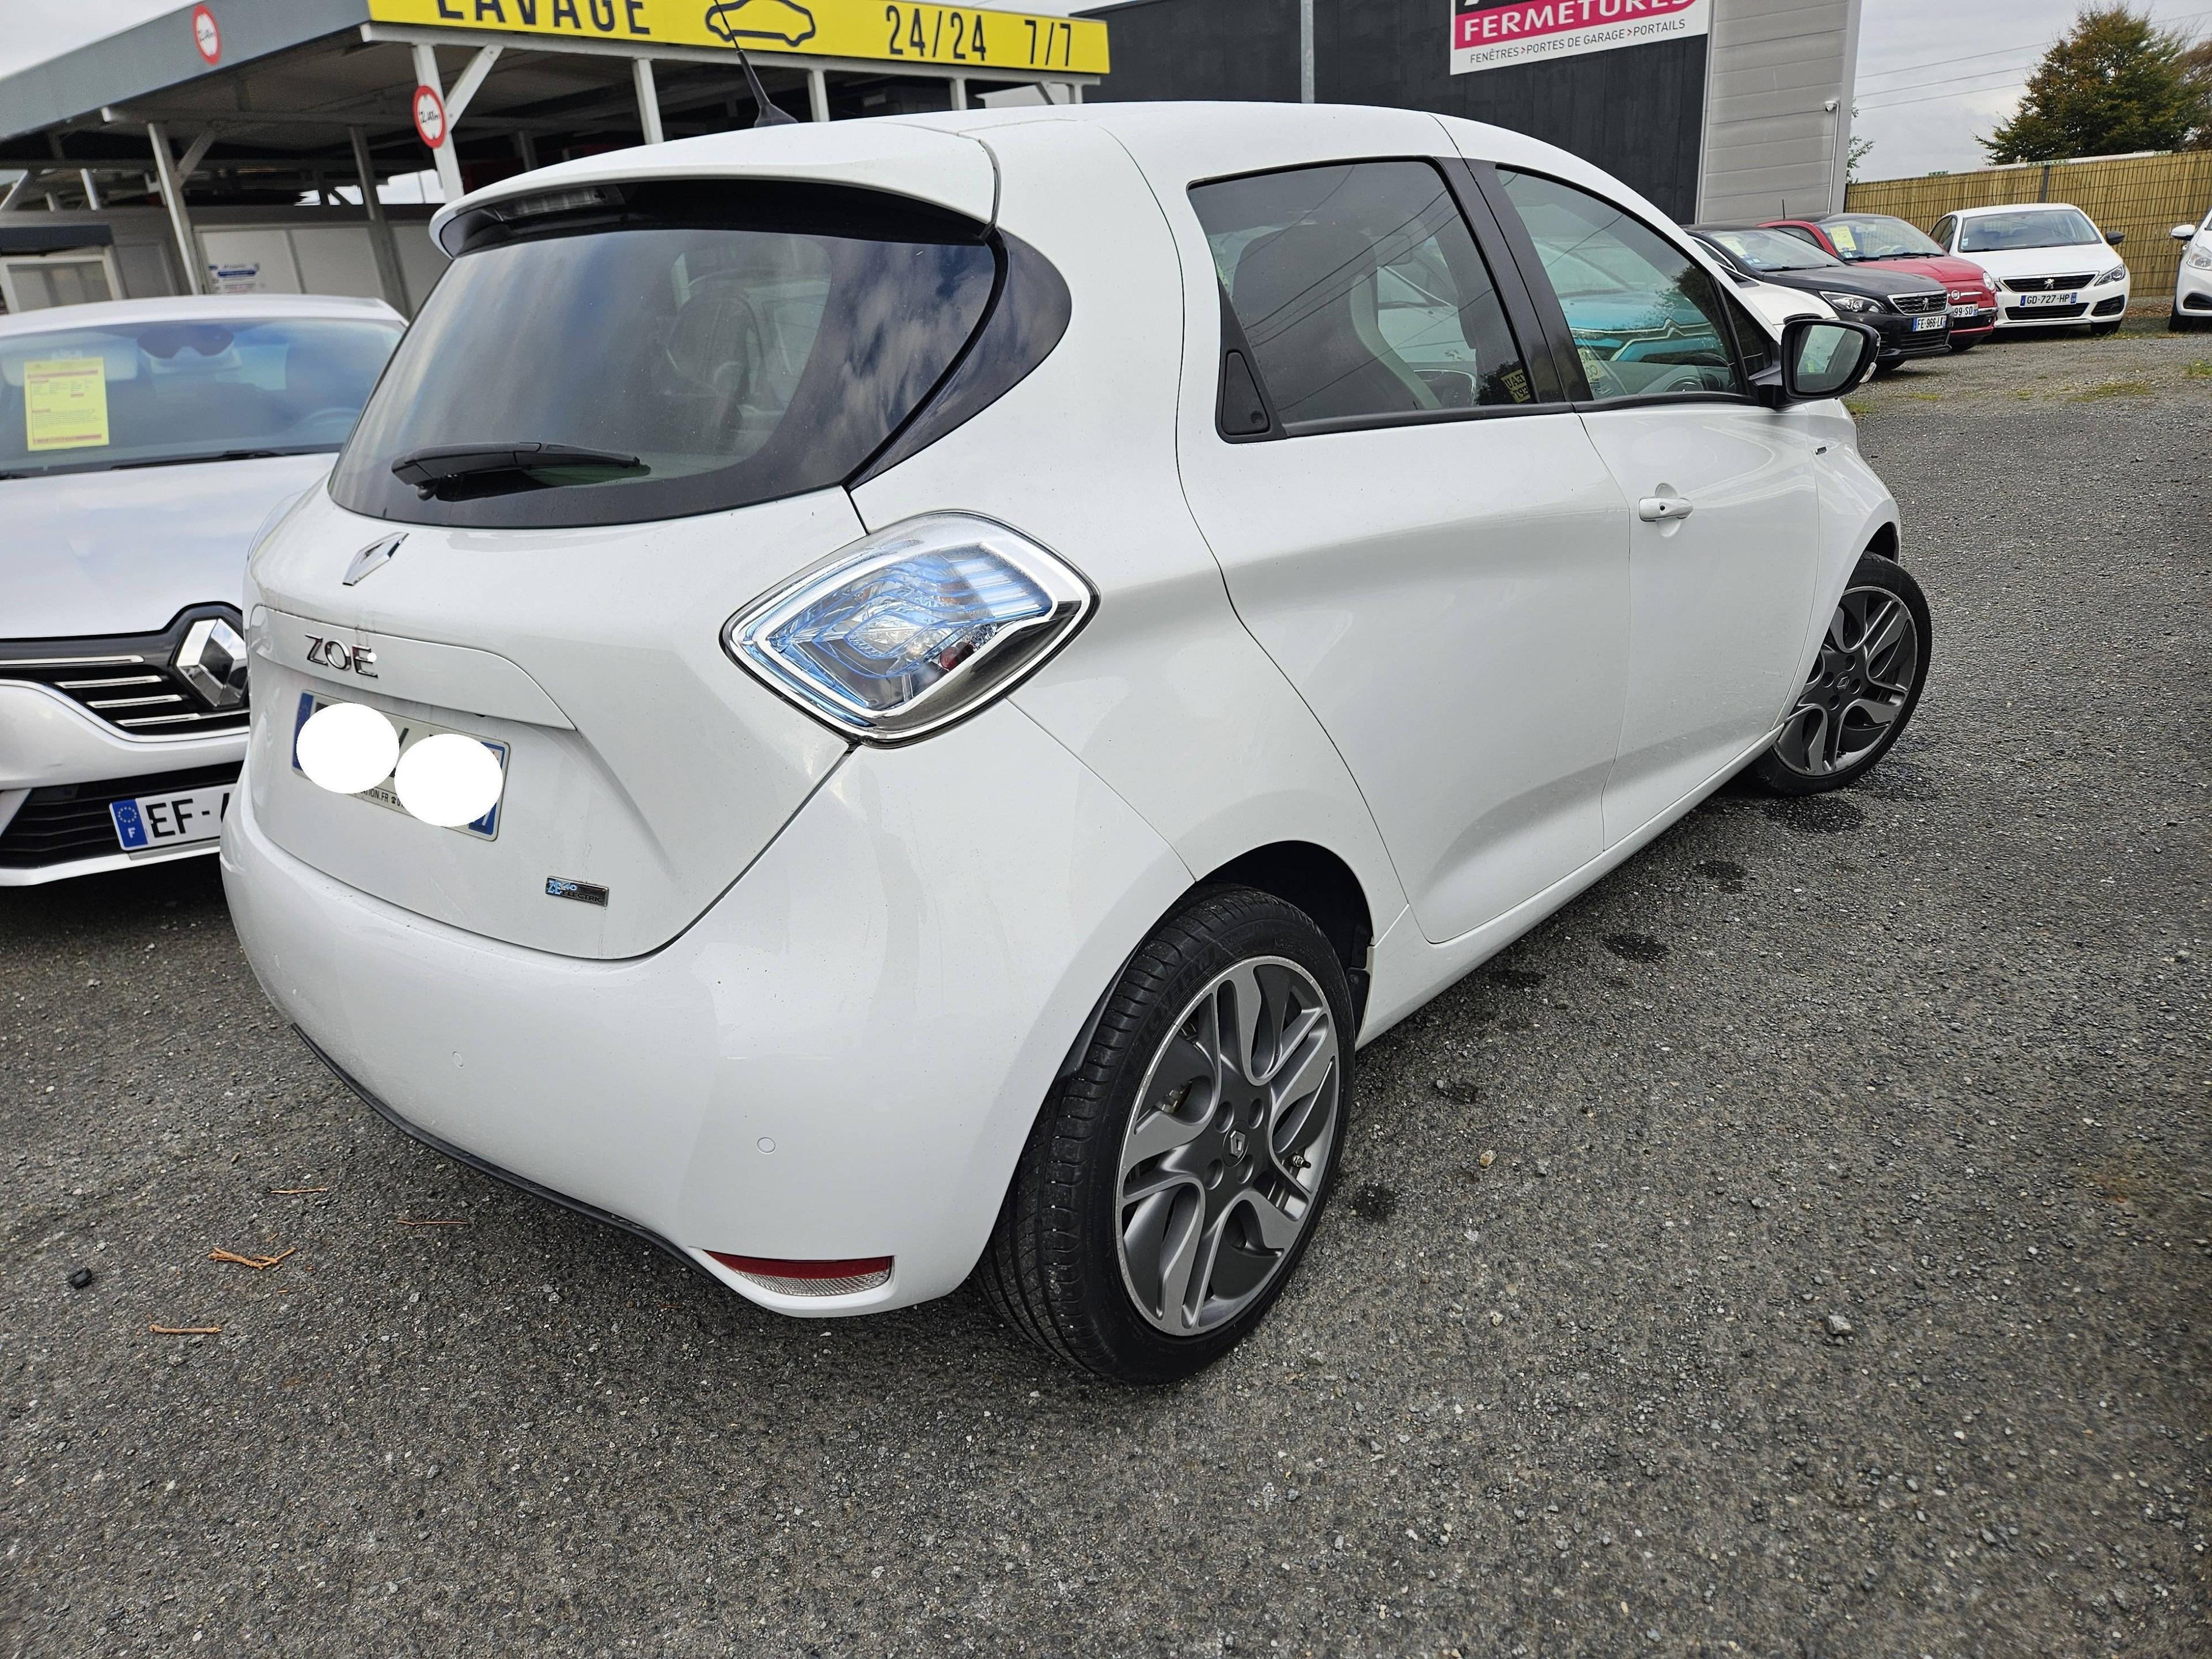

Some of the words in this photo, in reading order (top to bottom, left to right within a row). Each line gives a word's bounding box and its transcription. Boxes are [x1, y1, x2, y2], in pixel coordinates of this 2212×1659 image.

[886, 5, 986, 62] 24/24
[1024, 19, 1071, 66] 7/7
[1464, 0, 1688, 41] FERMETUR
[1470, 47, 1519, 63] FENÊTRES
[1527, 39, 1565, 54] PORTES
[1567, 36, 1581, 47] DE
[1584, 29, 1625, 44] GARAGE
[1633, 18, 1685, 36] PORTAILS
[2027, 294, 2070, 304] GD-727-HP
[305, 633, 378, 679] ZOE
[128, 827, 135, 838] F
[562, 891, 604, 904] ELECTRIC
